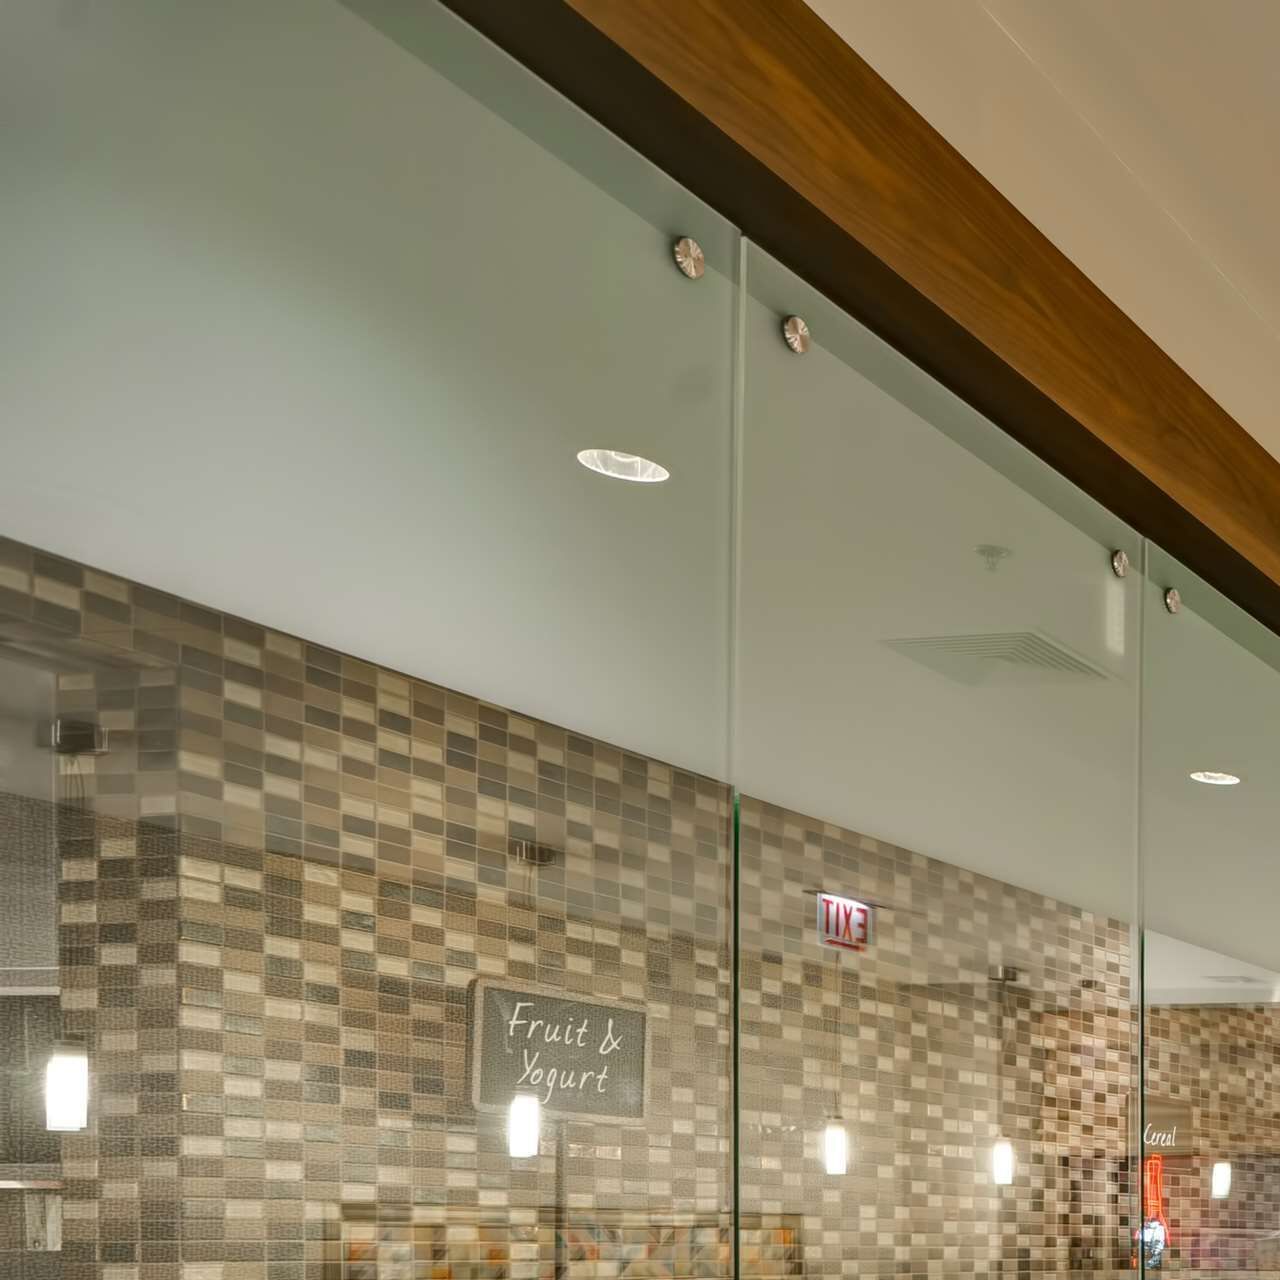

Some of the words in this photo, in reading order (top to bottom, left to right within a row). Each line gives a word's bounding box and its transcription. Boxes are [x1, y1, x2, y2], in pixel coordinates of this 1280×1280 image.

[508, 1001, 589, 1048] Fruit
[598, 1018, 623, 1055] &
[516, 1048, 609, 1105] Yogurt
[1143, 1122, 1177, 1147] Cereal
